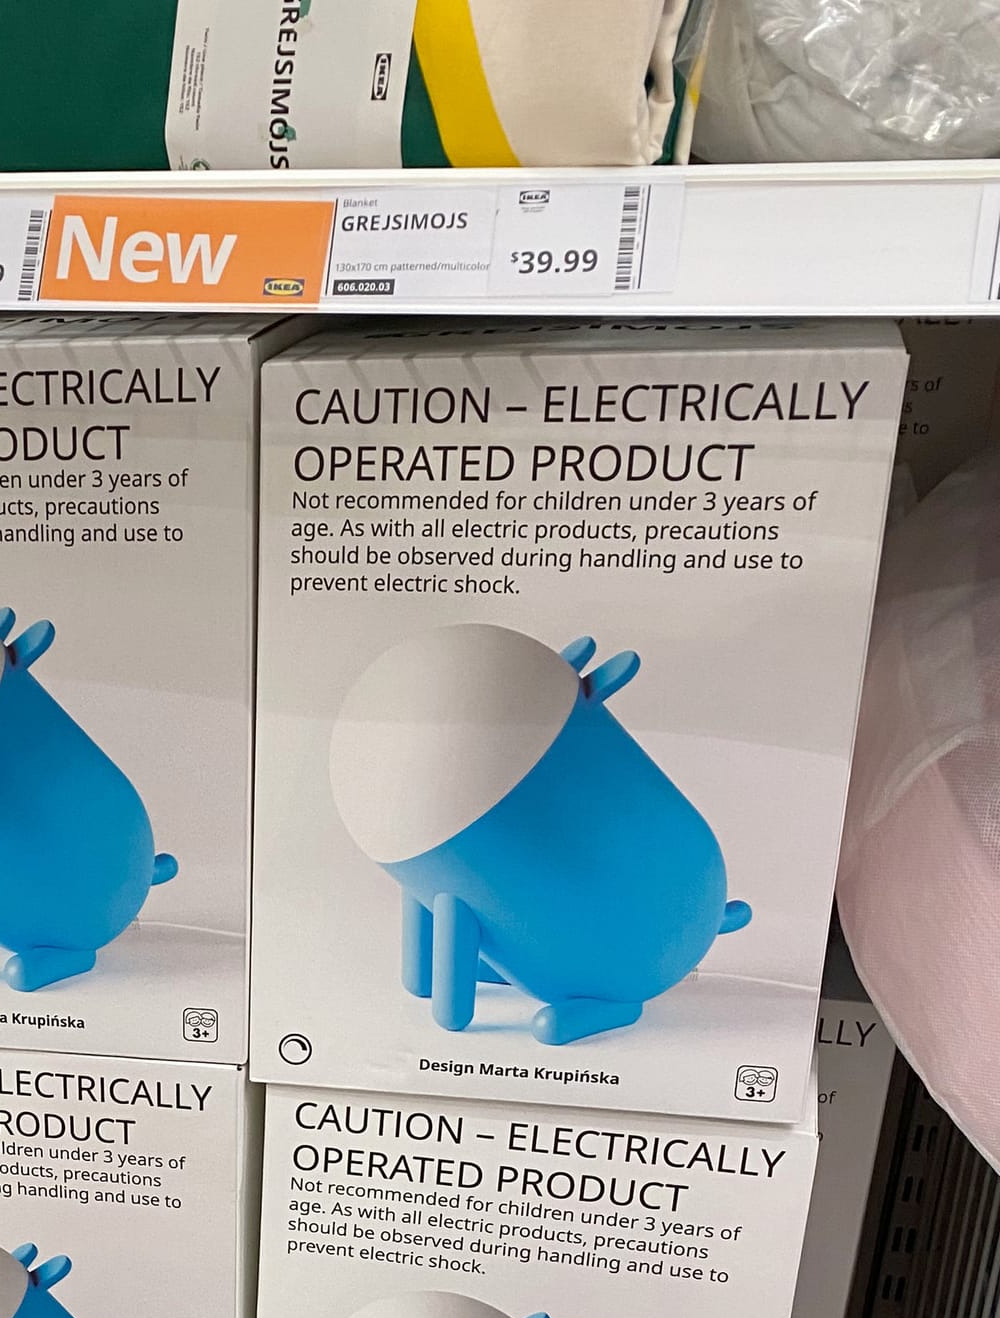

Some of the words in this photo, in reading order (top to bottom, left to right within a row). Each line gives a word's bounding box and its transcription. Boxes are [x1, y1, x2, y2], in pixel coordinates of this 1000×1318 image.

[269, 0, 301, 169] REJSIMOJS
[374, 56, 389, 98] IKEA
[343, 199, 378, 208] Blanket
[341, 212, 468, 232] GREJSIMOJS
[55, 214, 238, 285] New
[511, 248, 598, 274] $39.99
[335, 263, 371, 272] 130x170
[265, 281, 302, 293] IKEA
[337, 282, 390, 292] 606.020.03
[295, 386, 490, 425] CAUTION
[543, 380, 870, 423] ELECTRICALLY
[294, 445, 515, 482] OPERATED
[531, 443, 755, 482] PRODUCT
[11, 1012, 85, 1029] Krupińska
[191, 1025, 210, 1038] 3+
[419, 1058, 474, 1076] Design
[479, 1063, 529, 1078] Marta
[534, 1067, 619, 1085] Krupińska
[744, 1084, 767, 1098] 3+
[817, 1091, 837, 1104] of
[295, 1101, 463, 1145] CAUTION
[508, 1122, 786, 1178] ELECTRICALLY
[292, 1144, 483, 1189] OPERATED
[497, 1165, 689, 1212] PRODUCT
[288, 1200, 326, 1216] age.
[330, 1201, 353, 1217] As
[357, 1205, 396, 1222] with
[401, 1209, 422, 1225] all
[427, 1212, 494, 1234] electric
[498, 1223, 587, 1247] products,
[593, 1235, 709, 1259] precautions
